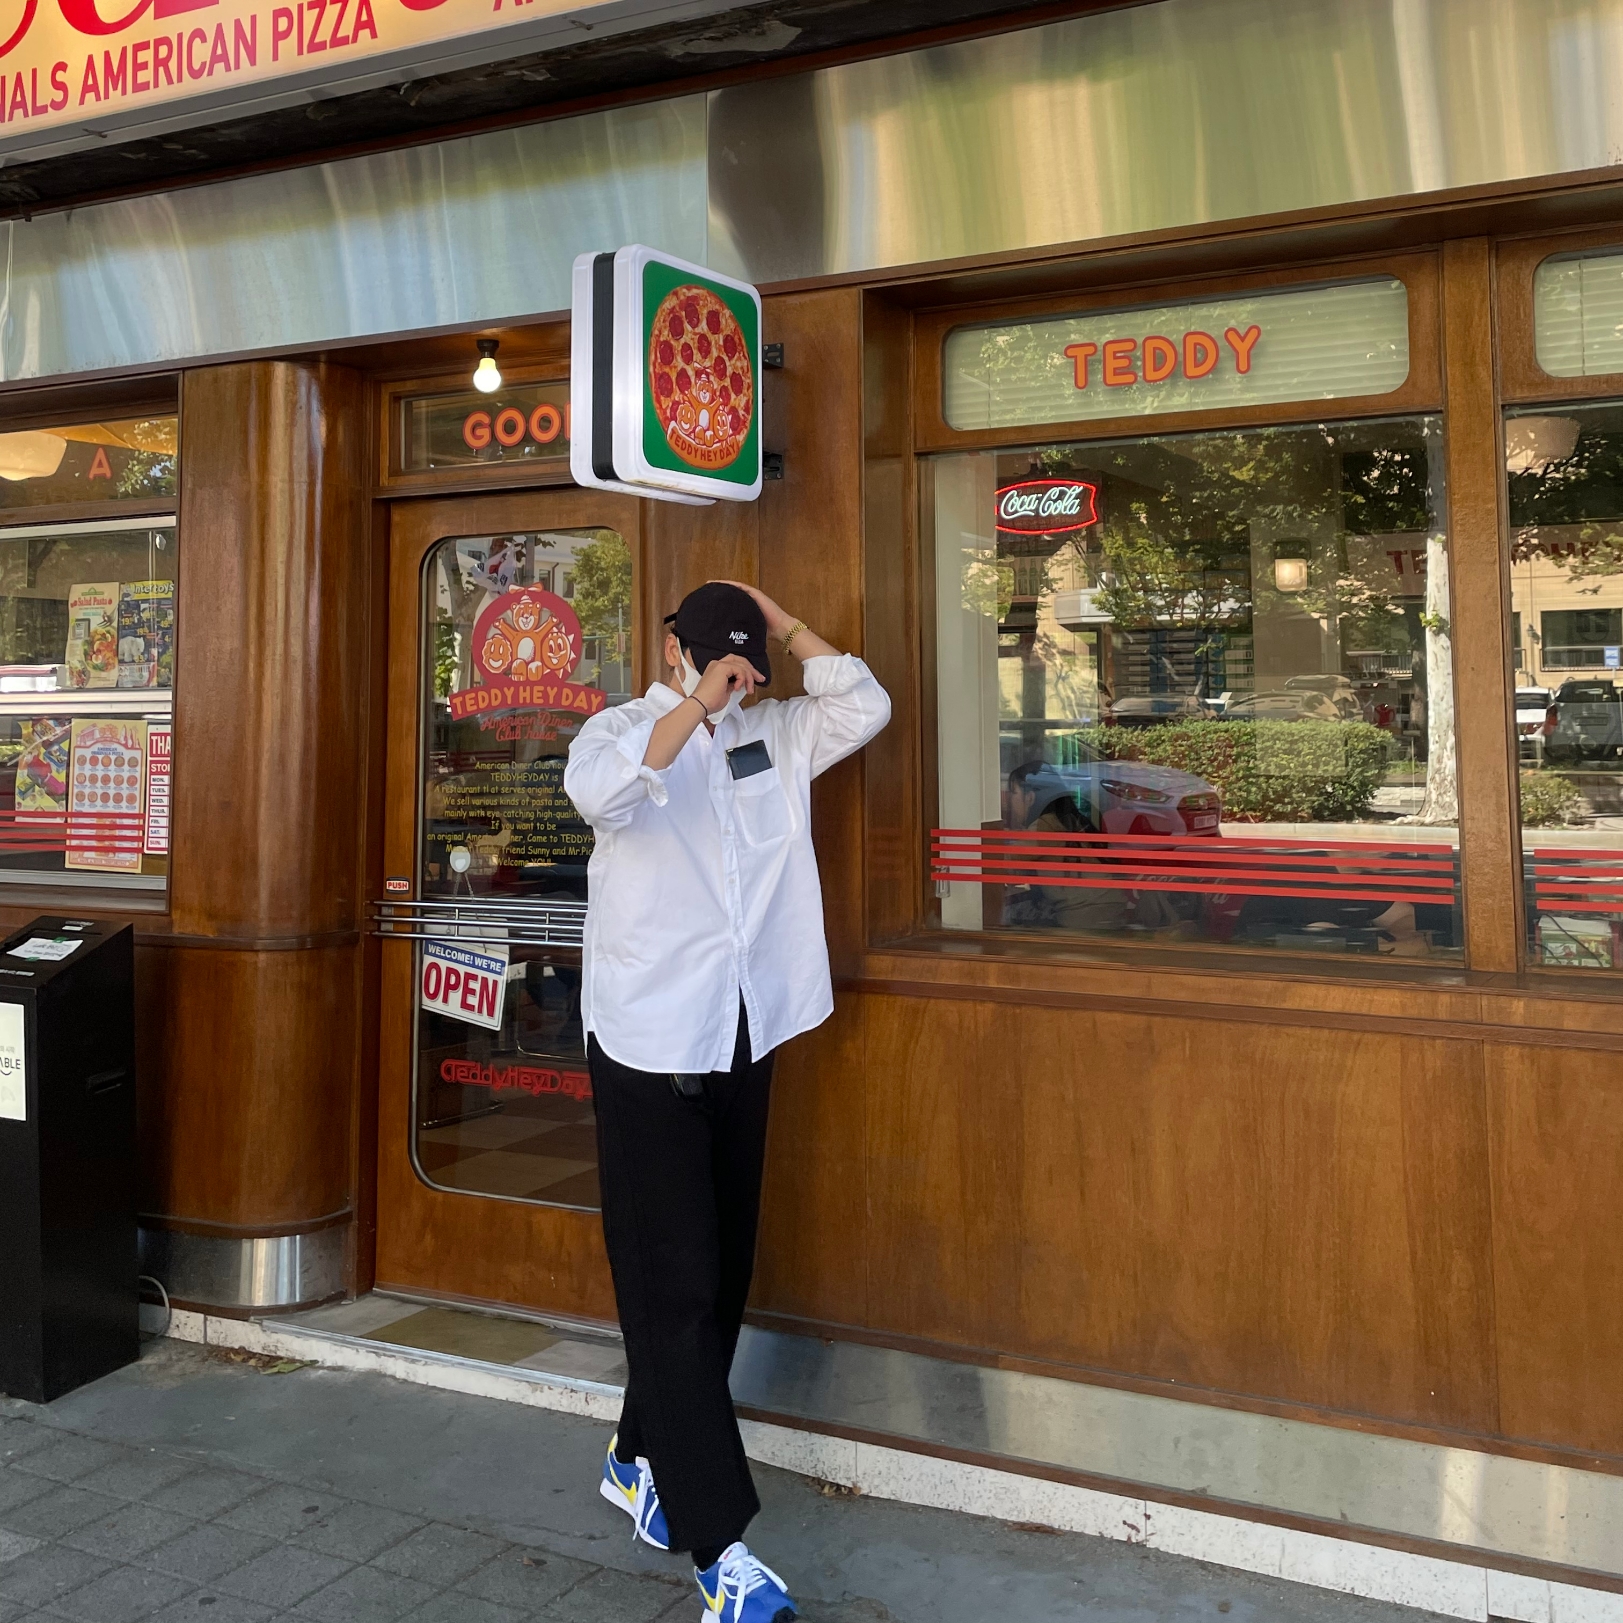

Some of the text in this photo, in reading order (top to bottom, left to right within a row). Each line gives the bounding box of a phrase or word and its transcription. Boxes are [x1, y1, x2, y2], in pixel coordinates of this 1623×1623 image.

[78, 14, 258, 106] AMERICAN
[272, 0, 379, 62] PIZZA
[1064, 324, 1262, 390] TEDDY
[463, 403, 570, 450] GOO
[88, 447, 113, 481] A
[1000, 485, 1084, 519] Coca-Cola
[480, 714, 537, 732] American
[495, 725, 522, 742] Club
[150, 763, 170, 773] STO
[475, 761, 510, 770] American
[534, 760, 550, 769] Club
[490, 772, 559, 782] TEDDYHEYDAY is
[441, 785, 481, 794] restaurant
[500, 785, 526, 794] serves
[527, 784, 555, 796] original
[442, 796, 455, 805] We
[456, 797, 470, 805] sell
[471, 797, 498, 806] various
[499, 797, 519, 806] kinds
[520, 797, 530, 806] of
[531, 798, 553, 808] pasta
[554, 797, 568, 806] and
[444, 807, 468, 820] mainly
[468, 808, 486, 818] with
[490, 820, 557, 832] If you want to be
[437, 832, 464, 843] original
[549, 835, 559, 843] to
[501, 845, 526, 855] friend
[527, 846, 550, 857] Sunny
[552, 846, 566, 856] and
[387, 881, 408, 890] PUSH
[428, 944, 502, 972] WELCOME! WE'RE
[423, 961, 499, 1018] OPEN
